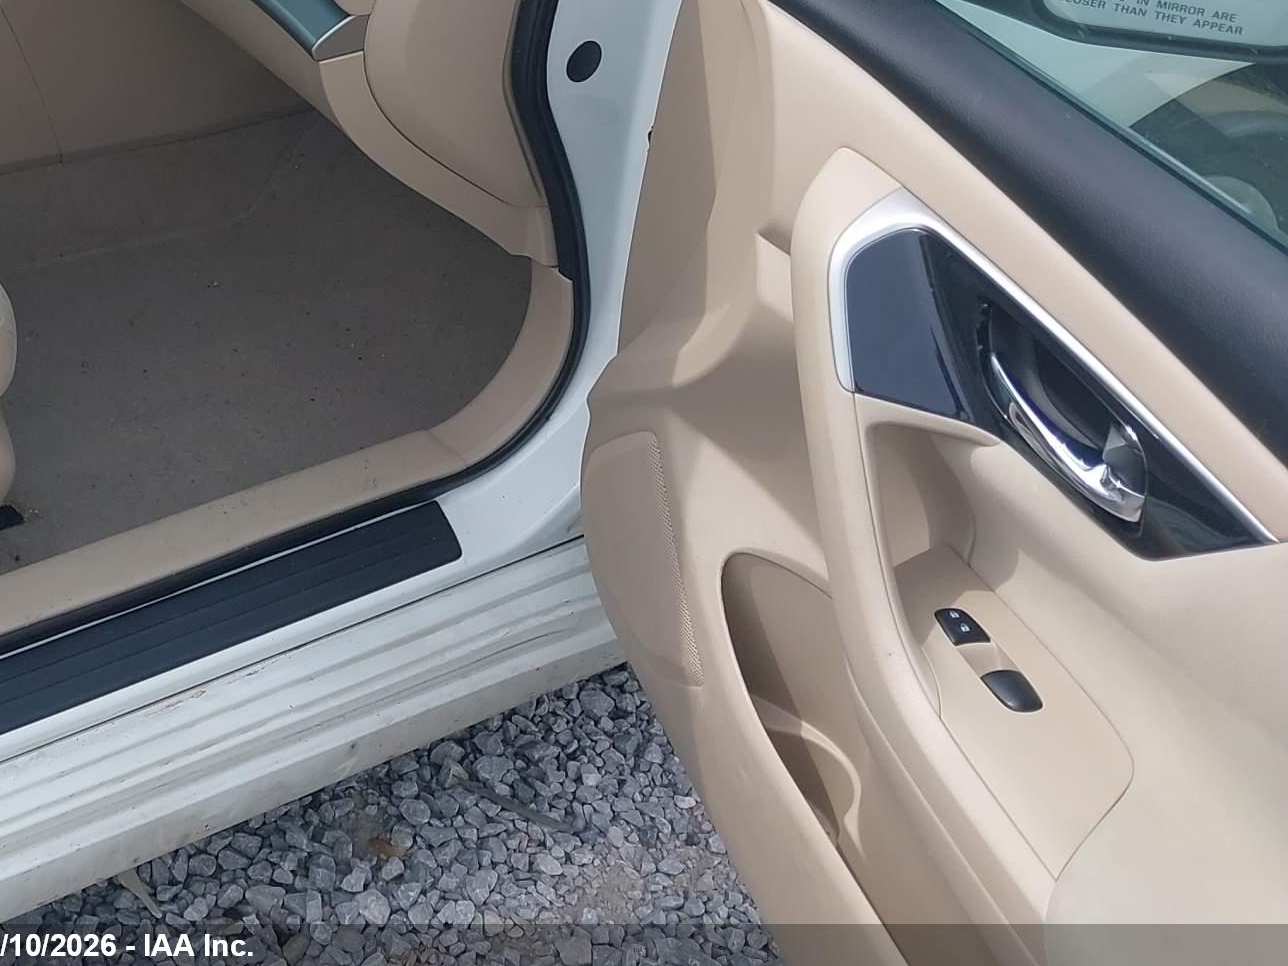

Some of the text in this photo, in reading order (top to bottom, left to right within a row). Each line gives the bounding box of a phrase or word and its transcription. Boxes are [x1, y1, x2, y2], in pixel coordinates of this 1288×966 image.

[1114, 3, 1147, 18] THAN
[1154, 11, 1187, 26] THEY
[1193, 19, 1244, 36] APPEAR
[1156, 0, 1205, 18] MIRROR
[1212, 10, 1238, 23] ARE
